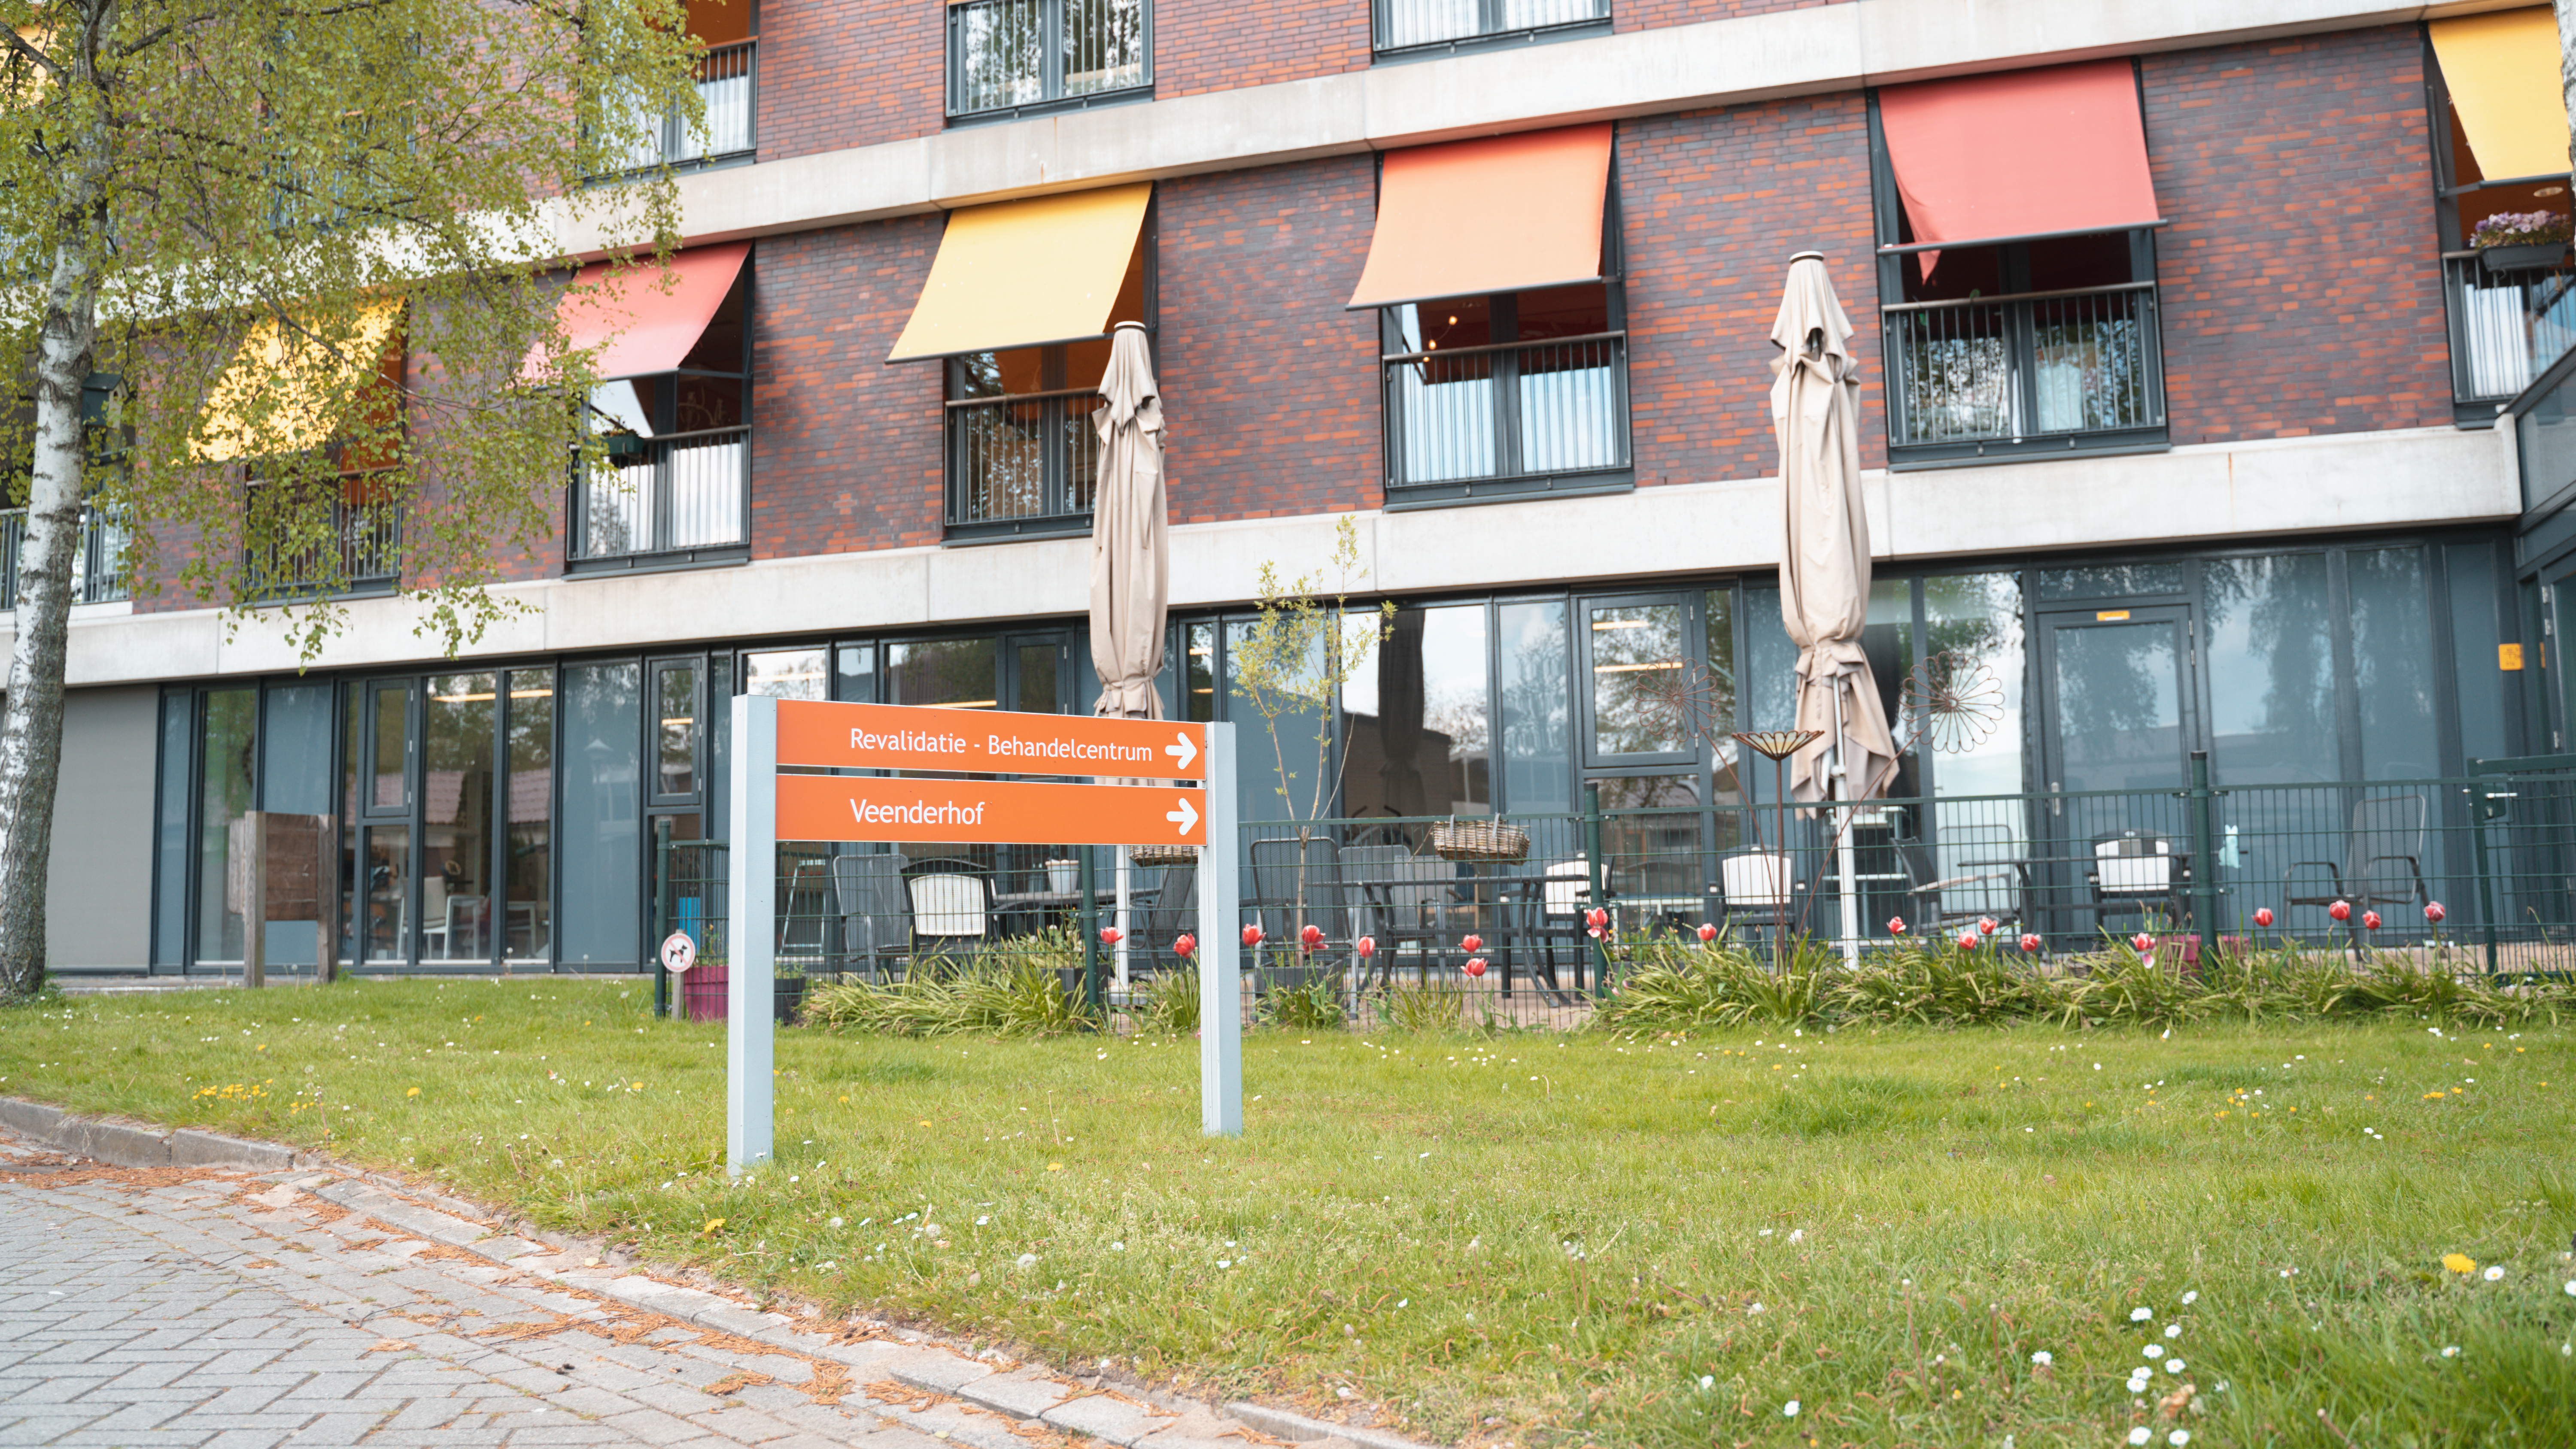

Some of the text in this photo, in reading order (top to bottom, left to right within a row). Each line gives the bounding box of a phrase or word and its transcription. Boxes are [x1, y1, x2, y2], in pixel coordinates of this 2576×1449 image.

[851, 728, 966, 753] Revalidatie
[989, 735, 1152, 761] Behandelcentrum
[850, 798, 985, 825] Veenderhof
